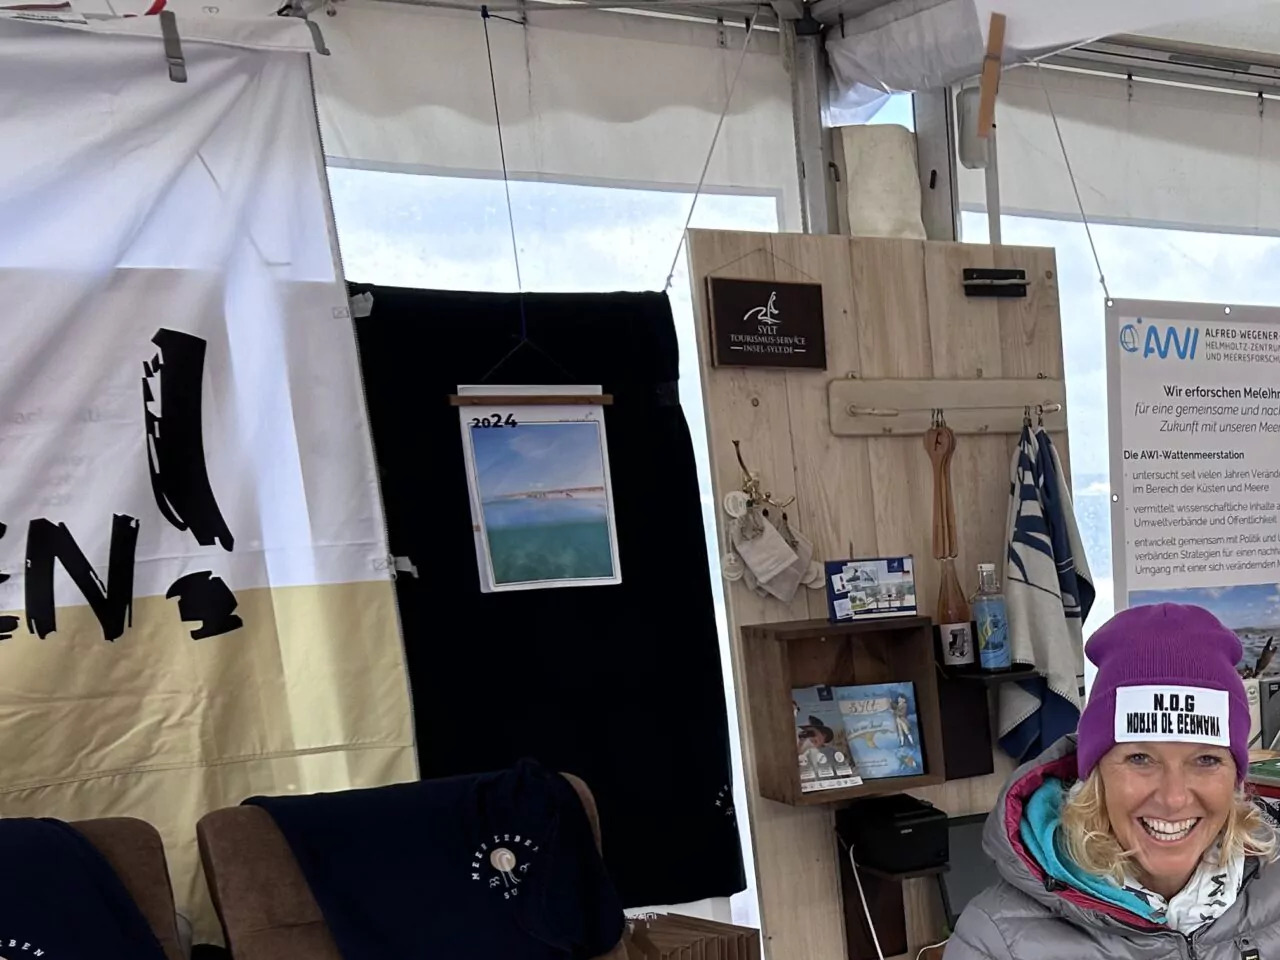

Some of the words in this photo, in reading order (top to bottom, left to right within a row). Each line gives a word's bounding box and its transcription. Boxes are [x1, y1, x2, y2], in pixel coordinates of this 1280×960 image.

[758, 325, 778, 335] SYLT
[730, 334, 806, 345] TOURISMUS-SERVICE
[1206, 353, 1222, 361] UND
[1164, 385, 1182, 398] Wir
[1185, 385, 1241, 399] erforschen
[1243, 387, 1280, 400] Me(e)hr
[1135, 402, 1150, 417] für
[1152, 403, 1173, 415] eine
[1175, 404, 1239, 420] gemeinsame
[1241, 403, 1259, 415] und
[471, 413, 518, 428] 2024
[1160, 420, 1199, 435] Zukunft
[1201, 421, 1217, 433] mit
[1219, 422, 1256, 433] unseren
[1124, 451, 1138, 460] Die
[1140, 450, 1245, 460] AWI-Wattenmeerstation
[1132, 470, 1178, 480] untersucht
[1180, 469, 1196, 479] seit
[1197, 469, 1222, 479] vielen
[1224, 469, 1250, 479] Jahren
[1132, 484, 1144, 493] im
[1146, 483, 1178, 493] Bereich
[1180, 483, 1195, 493] der
[1196, 482, 1225, 492] Küsten
[1227, 482, 1242, 492] und
[1244, 483, 1270, 492] Meere
[1133, 503, 1175, 514] vermittelt
[1177, 502, 1248, 513] wissenschaftliche
[1133, 516, 1207, 528] Umweltverbände
[1209, 516, 1225, 526] und
[1134, 536, 1176, 547] entwickelt
[1178, 535, 1224, 547] gemeinsam
[1226, 535, 1238, 544] mit
[1239, 533, 1261, 544] Politik
[1262, 533, 1276, 543] und
[1135, 550, 1178, 561] verbänden
[1180, 549, 1220, 561] Strategien
[1222, 548, 1233, 558] für
[1236, 548, 1256, 557] einen
[1135, 564, 1170, 577] Umgang
[1172, 564, 1185, 574] mit
[1187, 562, 1206, 573] einer
[1208, 561, 1224, 572] sich
[1226, 559, 1275, 571] verändernden
